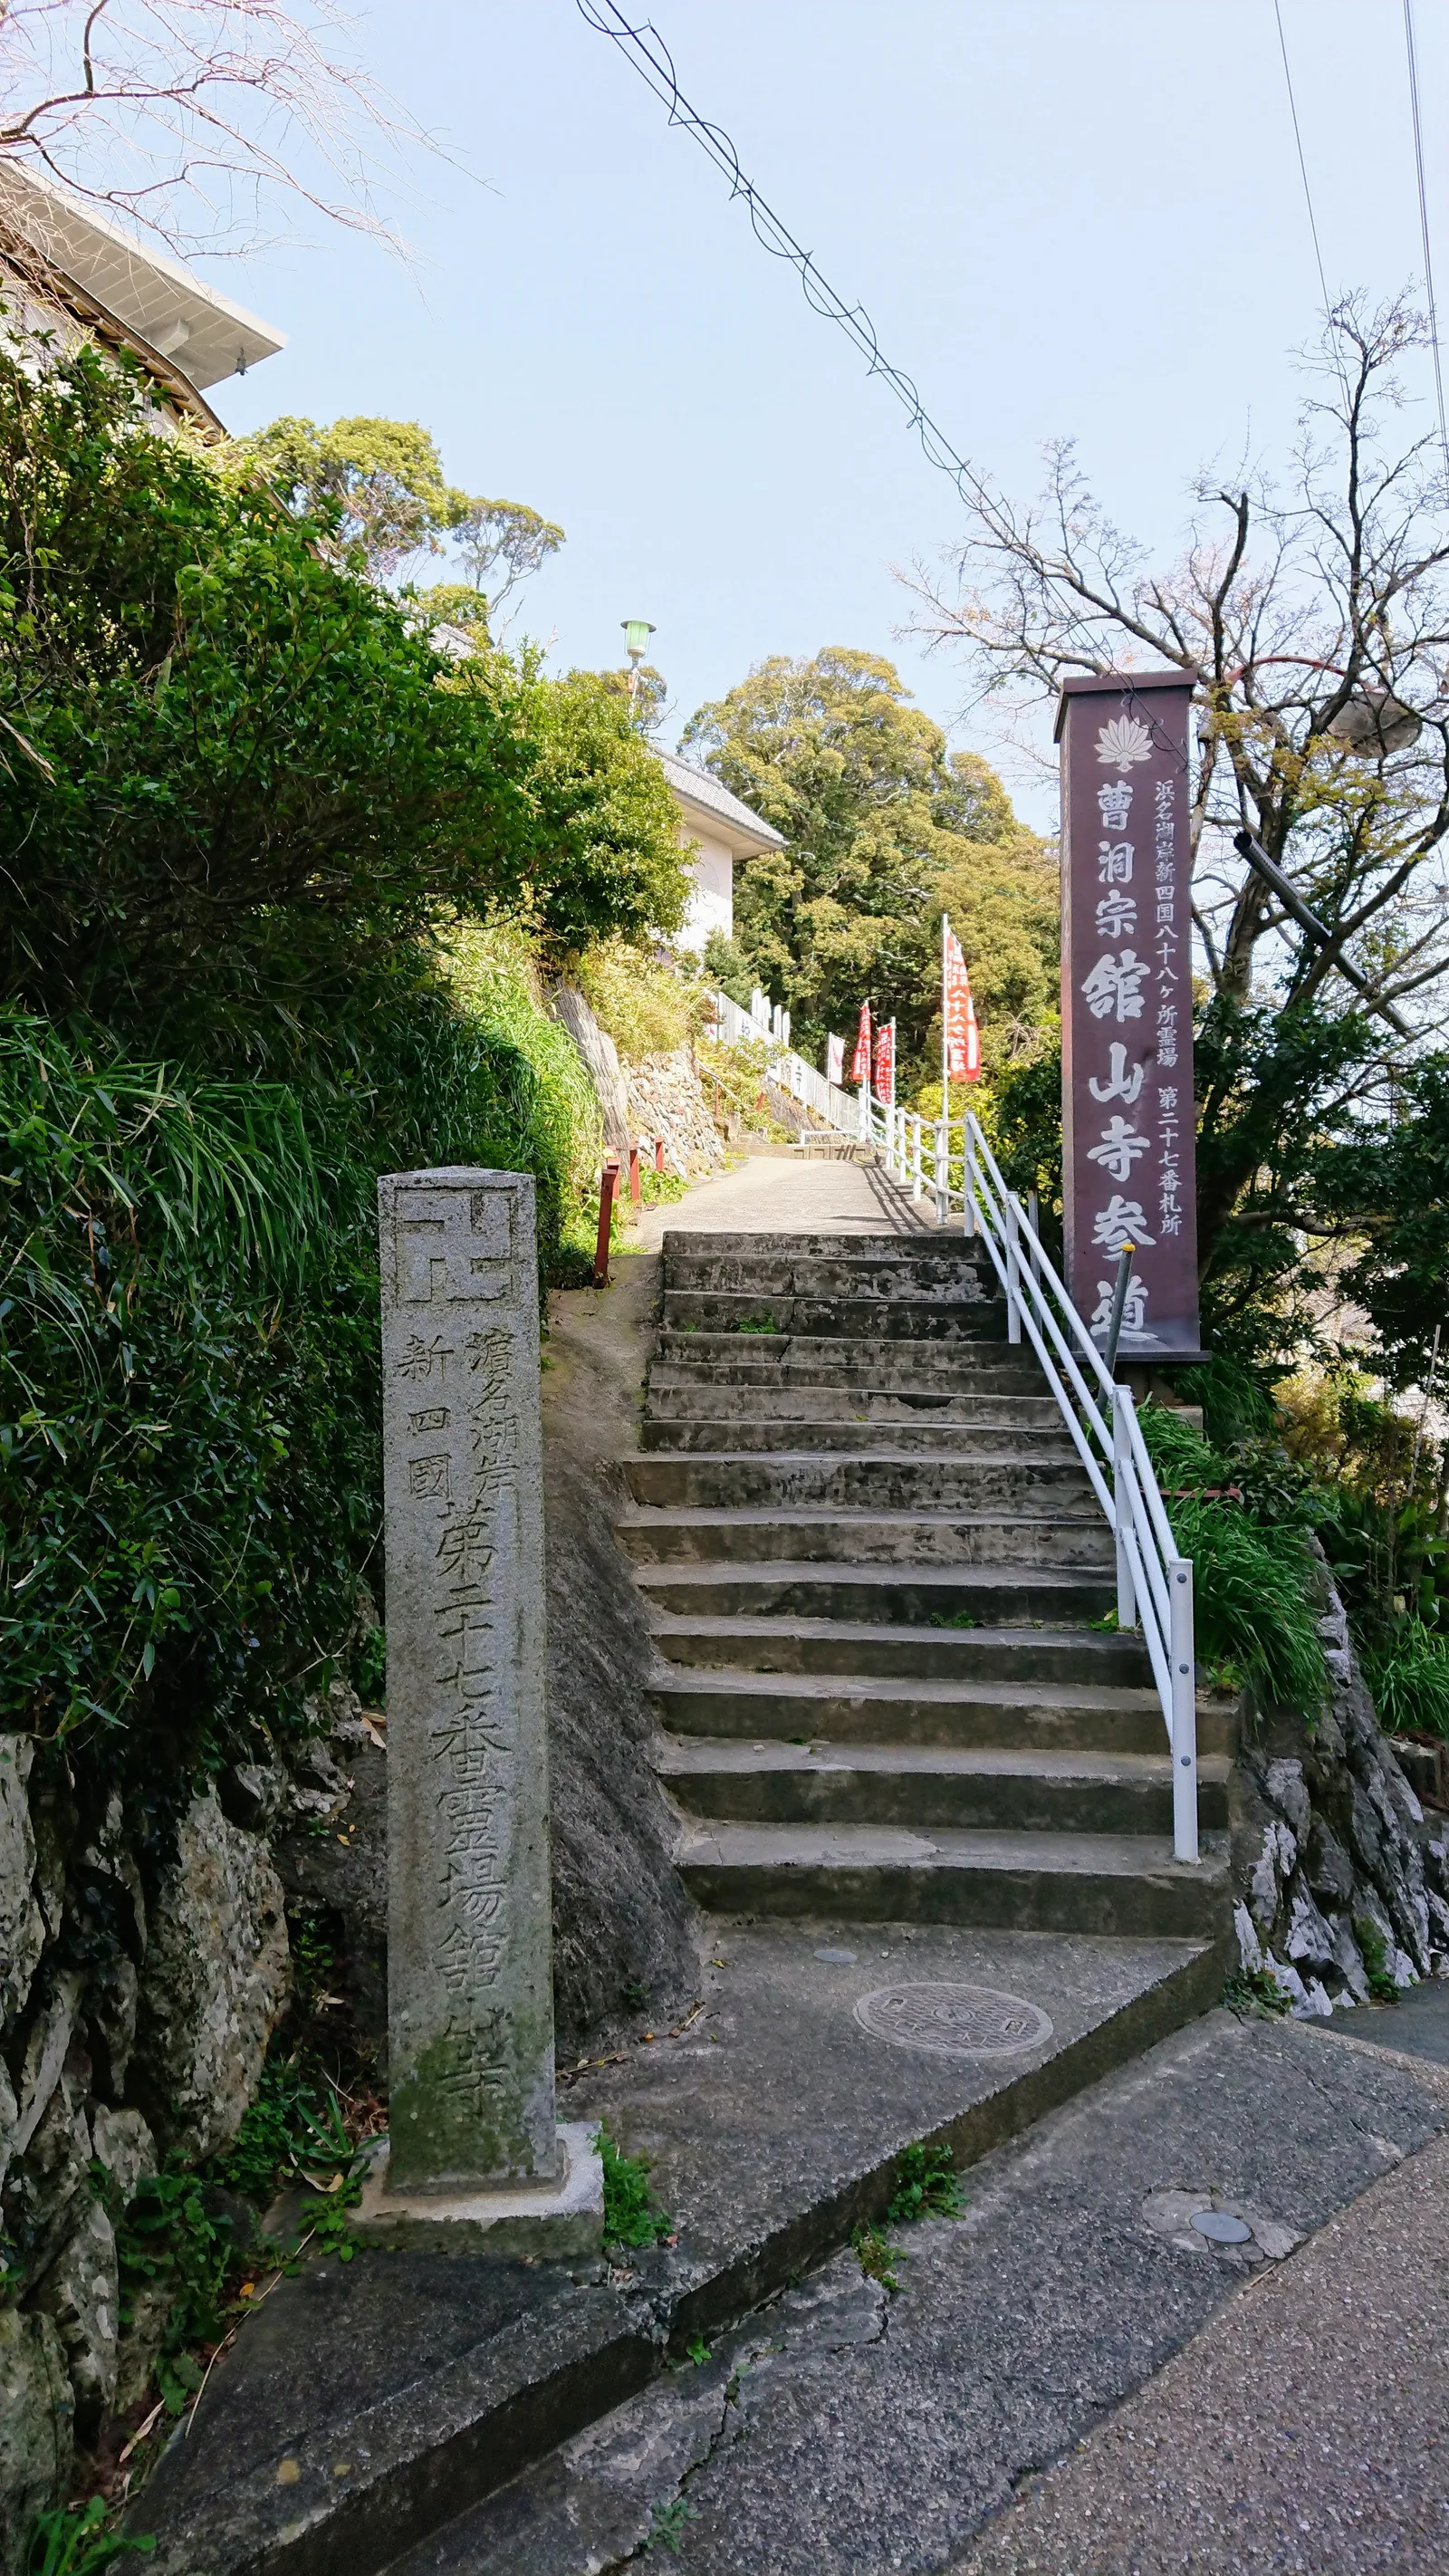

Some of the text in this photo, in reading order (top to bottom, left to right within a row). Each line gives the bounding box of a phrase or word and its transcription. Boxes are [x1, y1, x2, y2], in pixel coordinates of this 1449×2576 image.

[1157, 1087, 1183, 1237] 第二十七番札所
